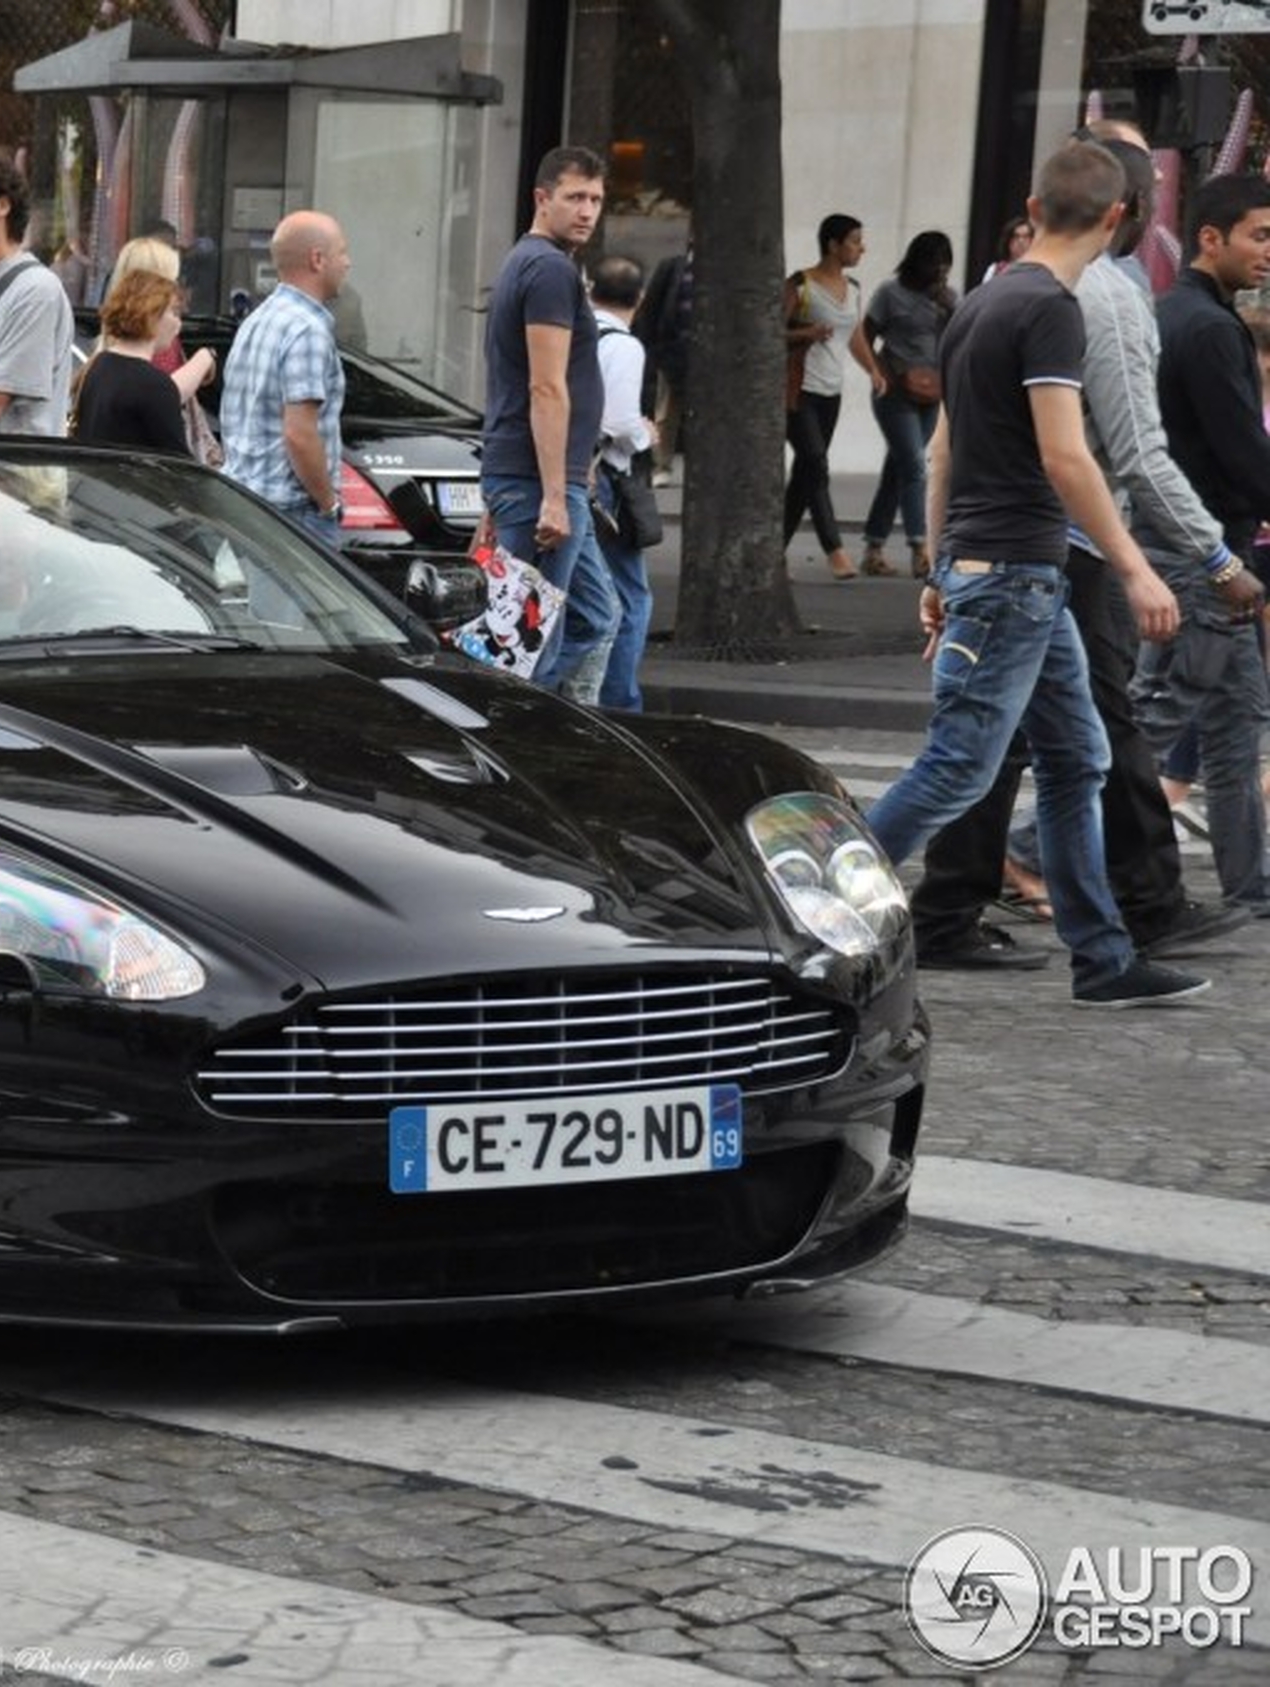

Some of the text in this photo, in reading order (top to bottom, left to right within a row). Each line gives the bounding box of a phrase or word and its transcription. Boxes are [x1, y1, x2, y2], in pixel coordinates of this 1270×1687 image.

[437, 1101, 705, 1174] CE-729-ND
[713, 1129, 738, 1158] 69
[403, 1161, 415, 1178] F
